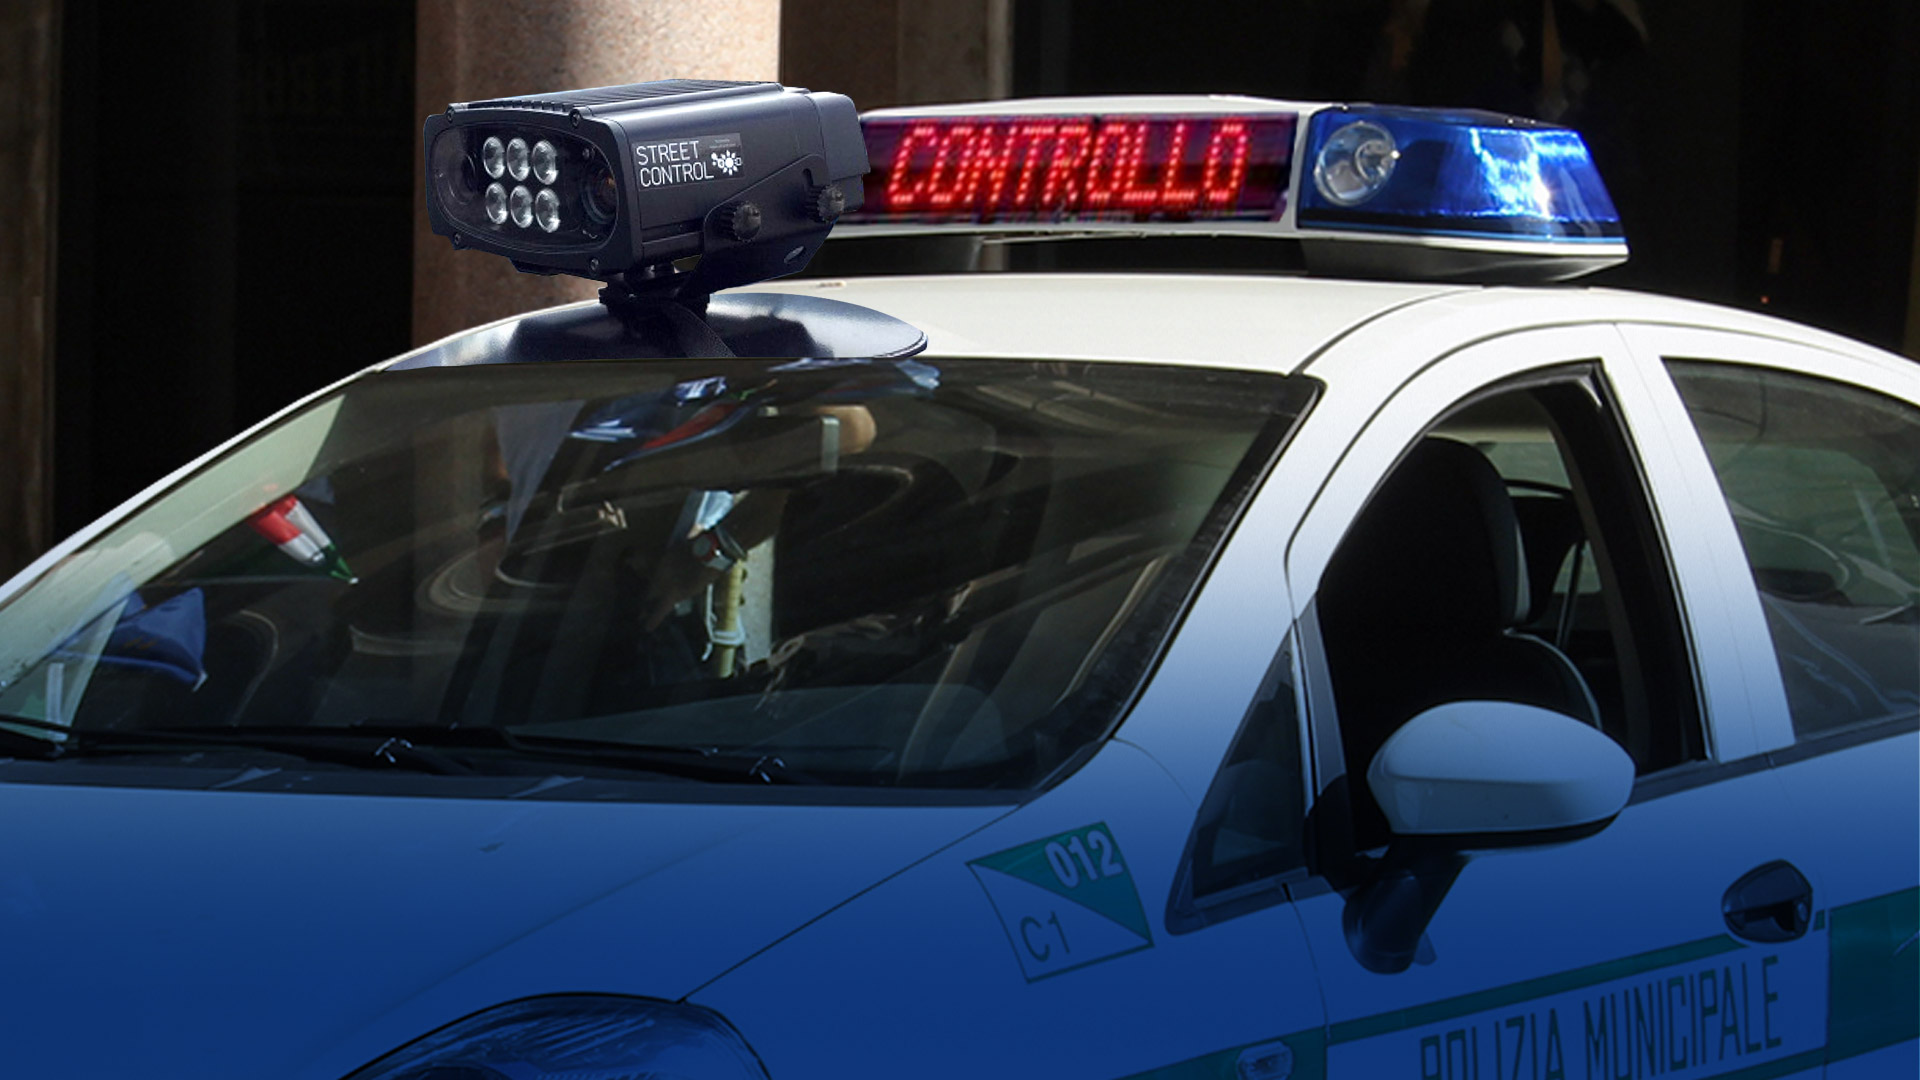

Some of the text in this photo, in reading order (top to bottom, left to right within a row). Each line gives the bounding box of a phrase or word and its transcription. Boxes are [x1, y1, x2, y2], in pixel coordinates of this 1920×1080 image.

[636, 140, 699, 166] STREET
[640, 162, 714, 187] CONTROL
[887, 122, 1248, 205] CONTROLLO
[1044, 829, 1124, 889] 012
[1019, 911, 1070, 962] C1
[1584, 954, 1782, 1080] MUNICIPALE
